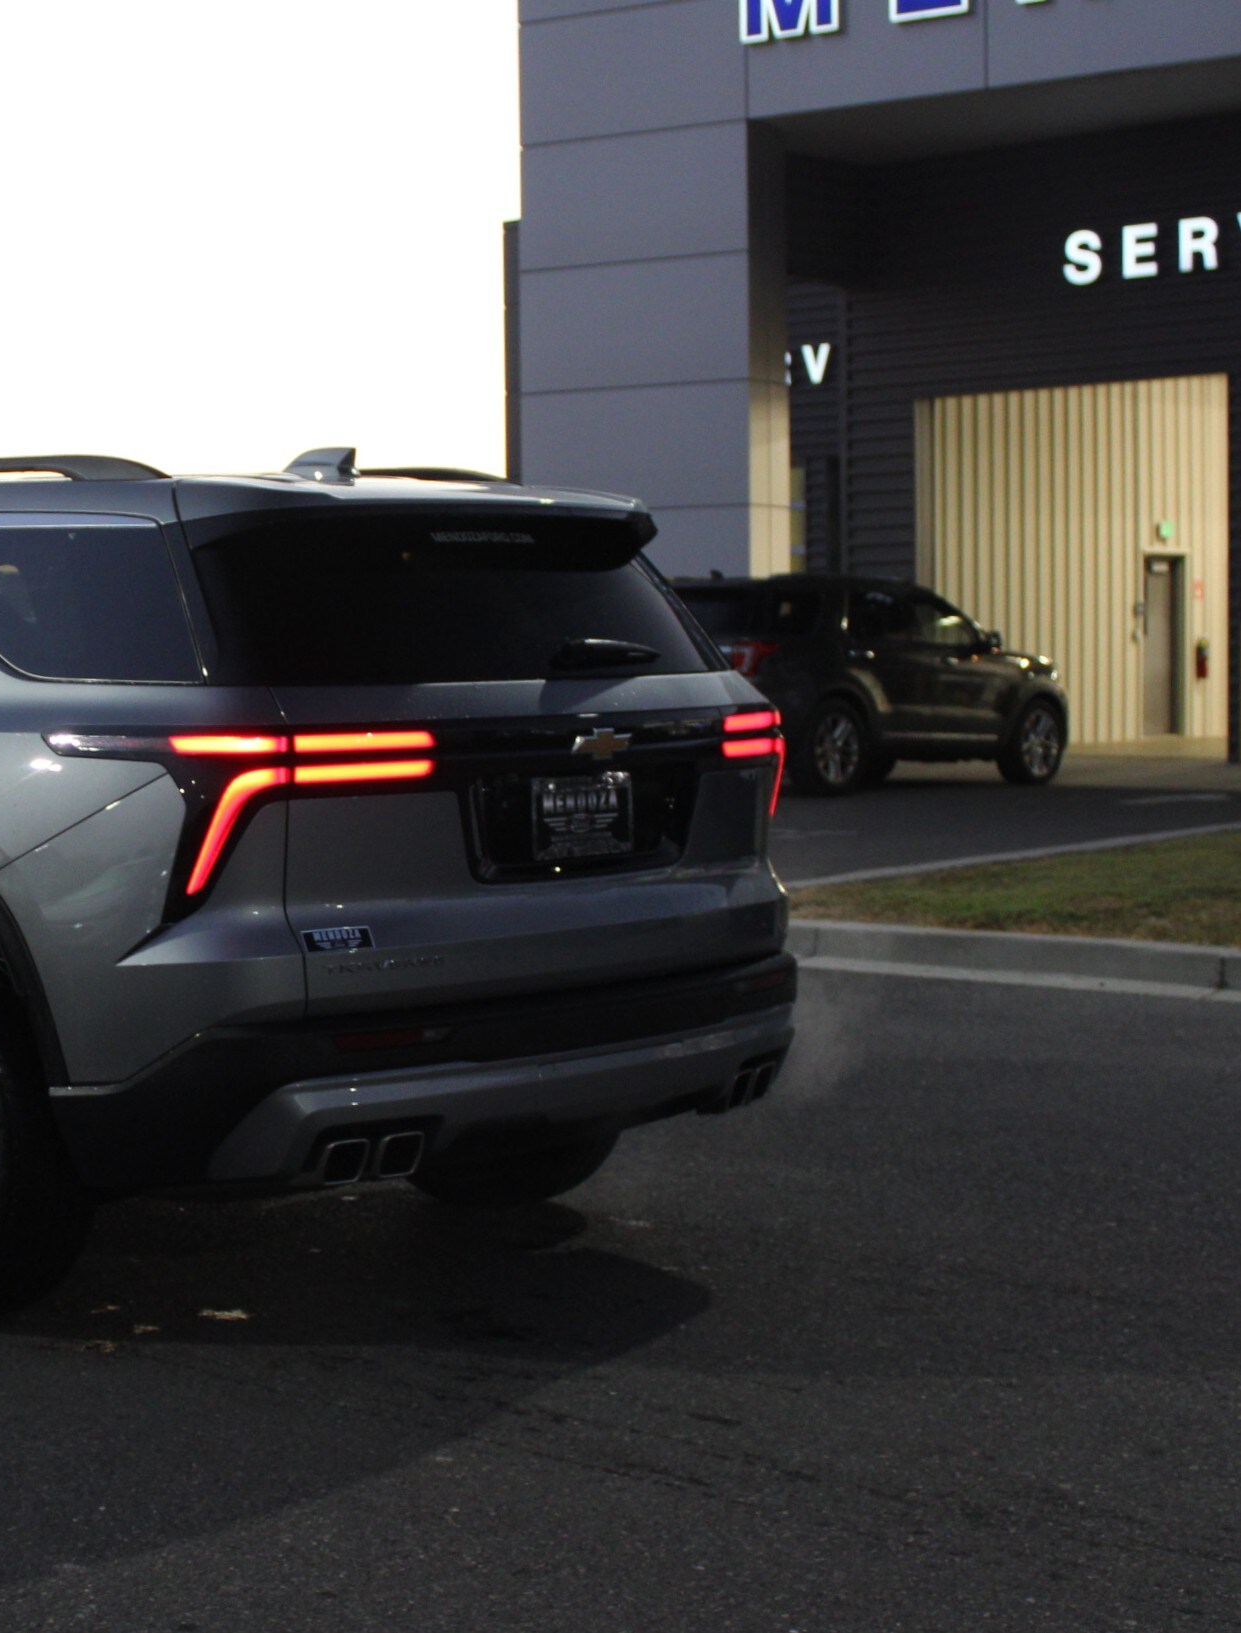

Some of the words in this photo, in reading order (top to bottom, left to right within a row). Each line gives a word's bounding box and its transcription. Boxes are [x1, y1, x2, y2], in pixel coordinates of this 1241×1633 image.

[1063, 212, 1241, 286] SER
[784, 342, 831, 385] V
[542, 788, 618, 814] MENDOZA
[312, 928, 362, 942] MENDOZA
